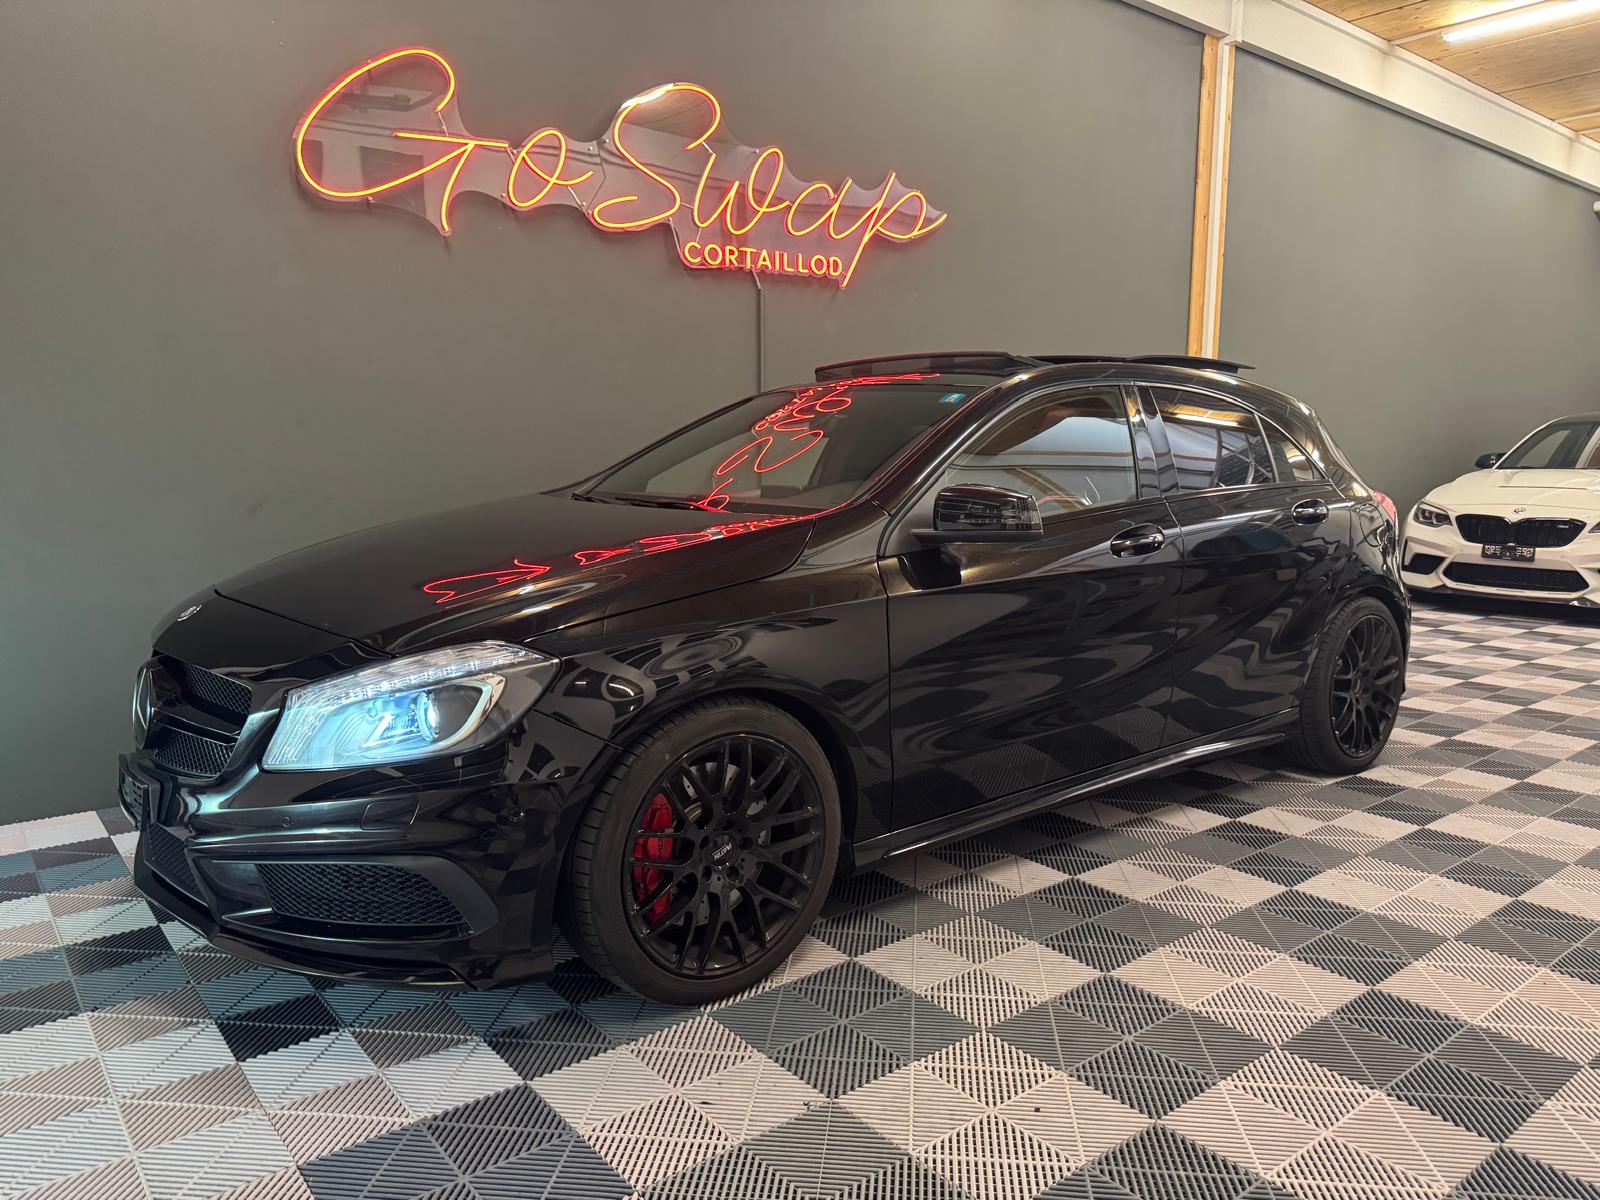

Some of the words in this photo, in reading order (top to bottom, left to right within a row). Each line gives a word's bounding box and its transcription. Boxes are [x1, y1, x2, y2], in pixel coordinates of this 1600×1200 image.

[296, 47, 594, 236] Go
[592, 82, 948, 288] Swap
[684, 241, 843, 277] CORTAILLOD
